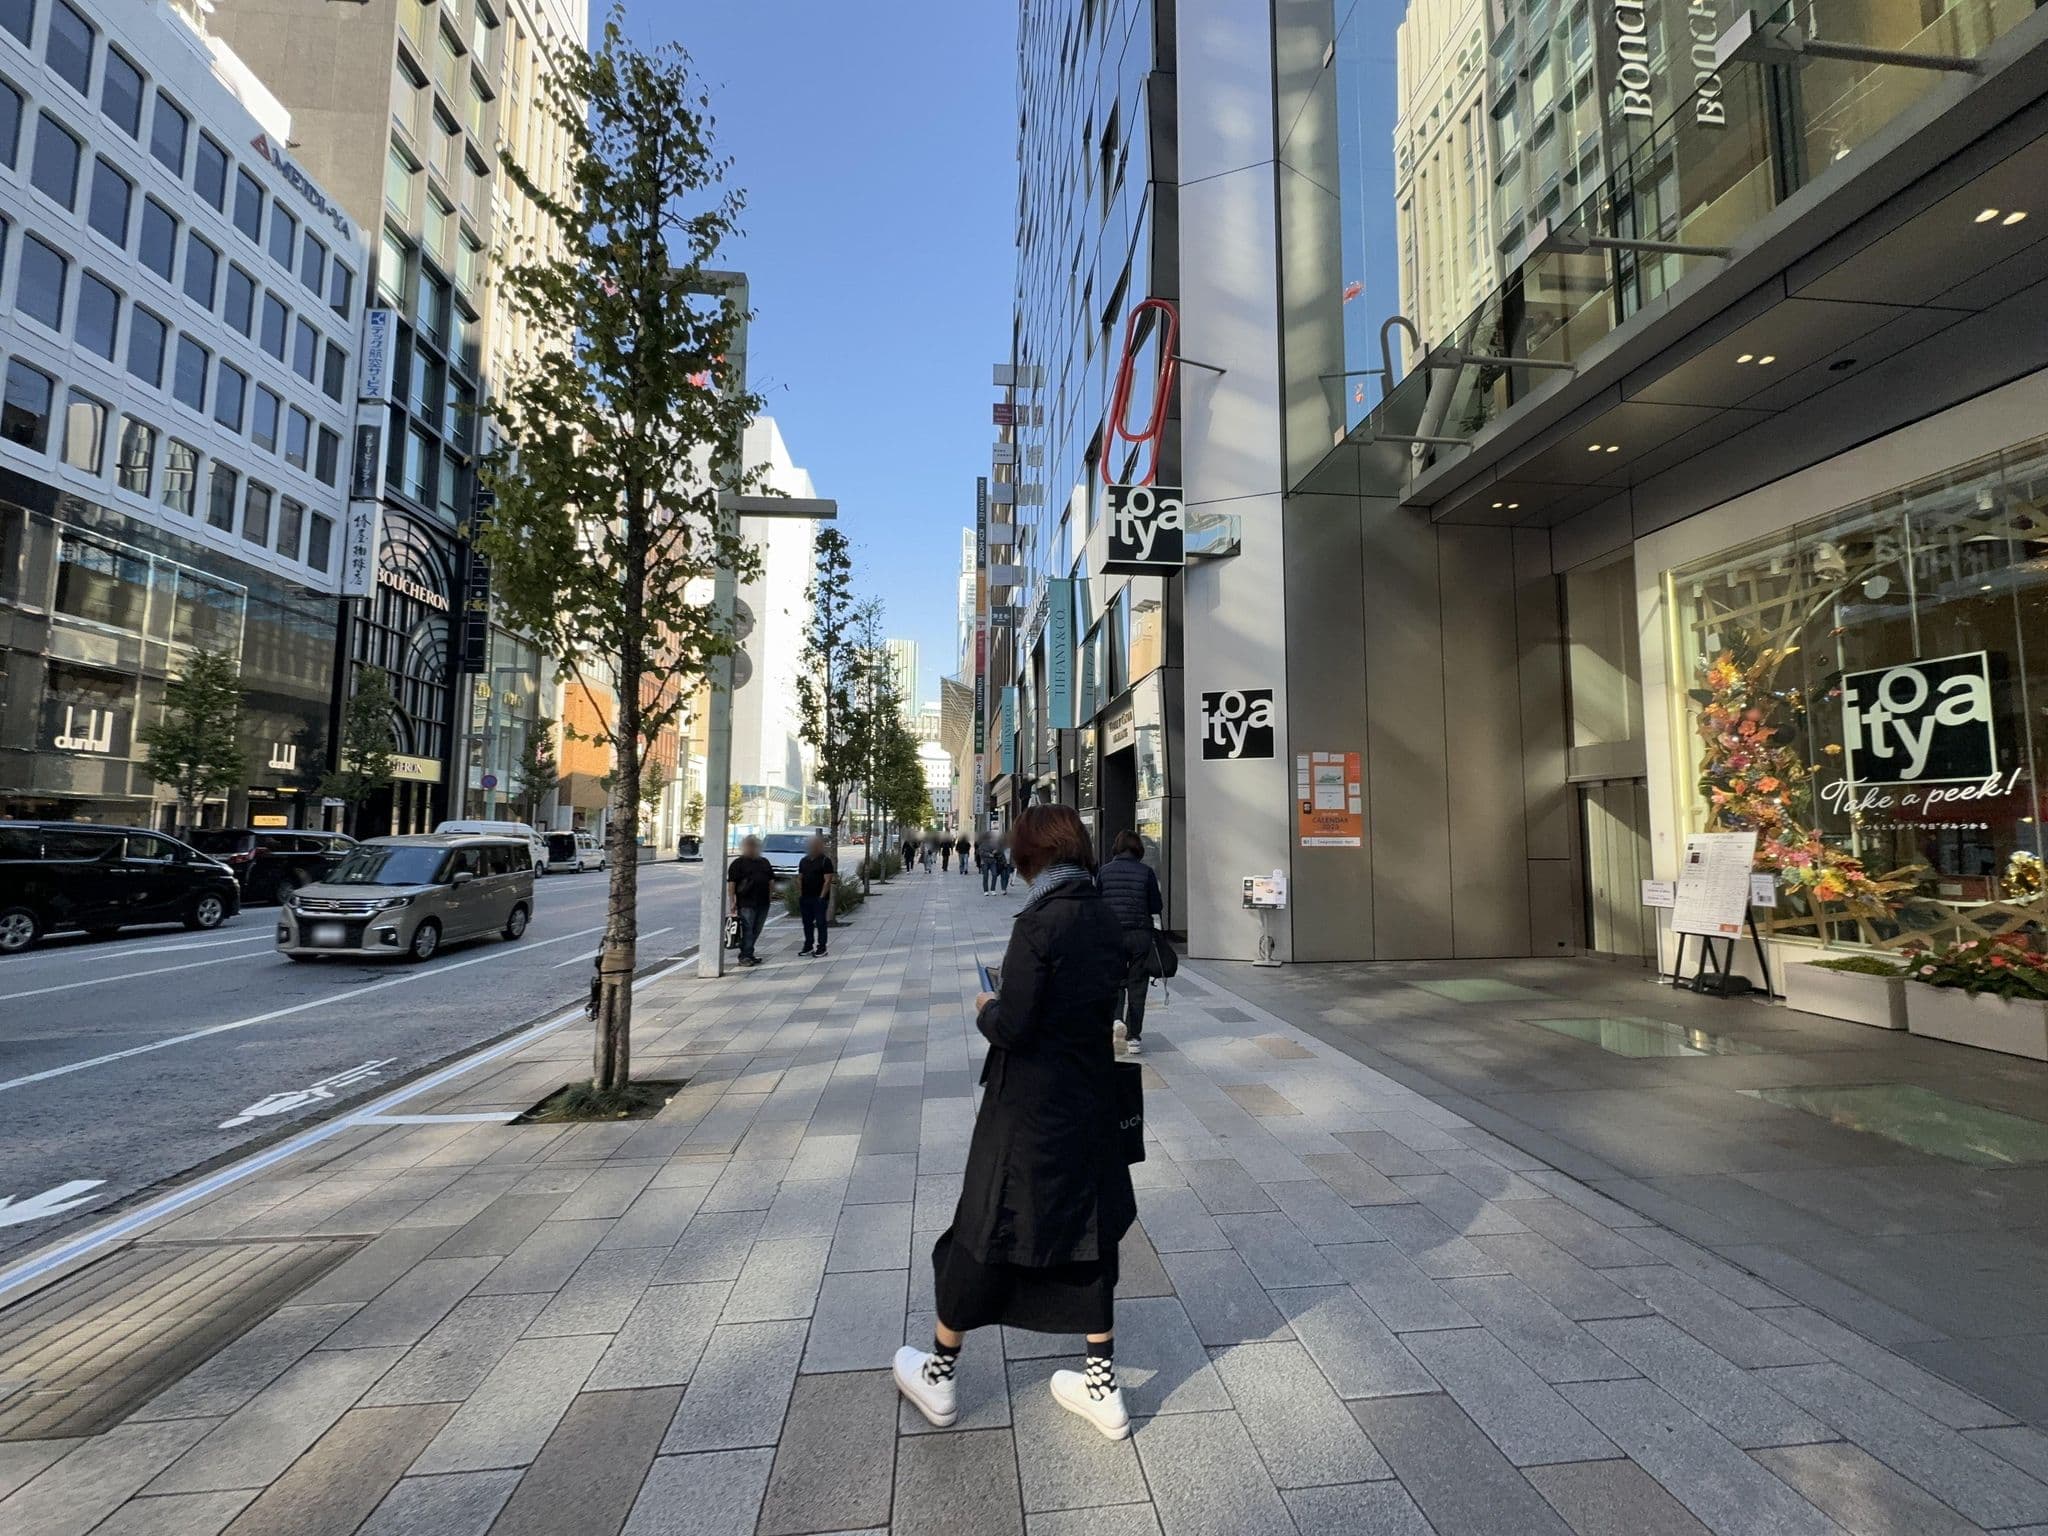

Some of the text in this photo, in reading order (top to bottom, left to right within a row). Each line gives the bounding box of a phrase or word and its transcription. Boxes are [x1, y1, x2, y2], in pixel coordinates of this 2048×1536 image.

[1107, 486, 1184, 561] itoya
[377, 567, 450, 612] BOUCHERON
[1201, 690, 1275, 759] itoya
[1845, 666, 1991, 780] itoya
[1820, 767, 2023, 816] Take a peek!
